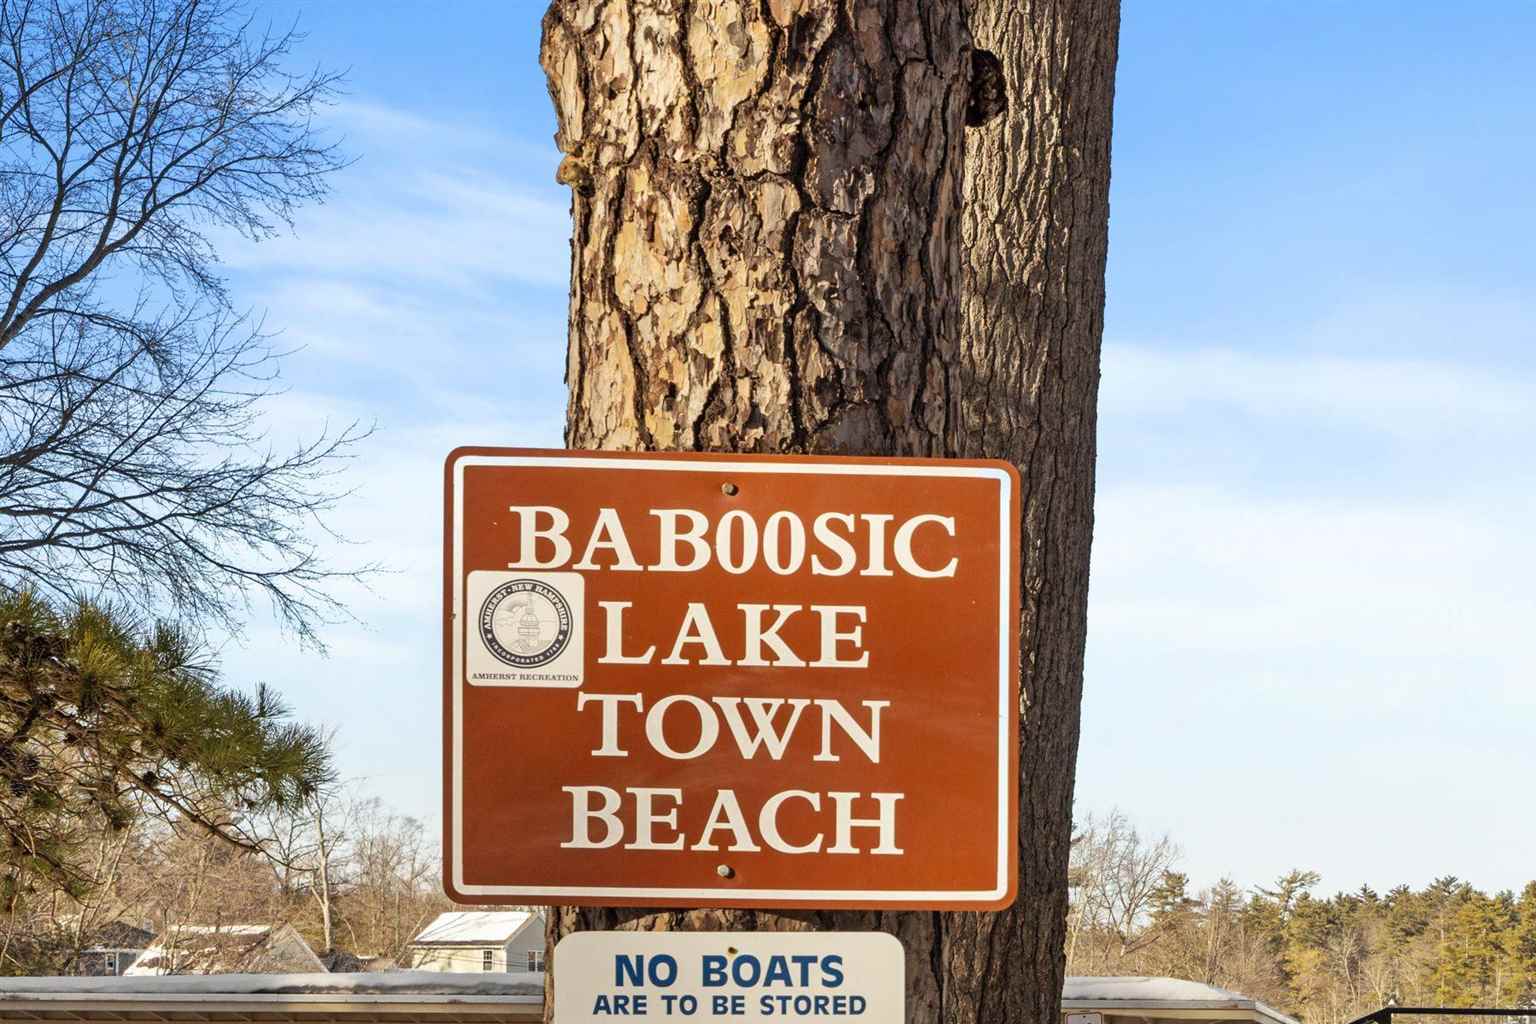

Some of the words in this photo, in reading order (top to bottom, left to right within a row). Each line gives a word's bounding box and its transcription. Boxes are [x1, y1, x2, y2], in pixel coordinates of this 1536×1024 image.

[511, 583, 533, 592] NEW
[535, 584, 568, 631] HAMPSHIRE
[597, 600, 871, 669] LAKE
[472, 672, 517, 680] AMHERST
[518, 673, 579, 681] RECREATION
[577, 691, 891, 765] TOWN
[560, 785, 905, 856] BEACH
[614, 954, 679, 988] NO
[702, 954, 844, 988] BOATS
[592, 995, 648, 1016] ARE
[661, 995, 698, 1016] TO
[712, 995, 745, 1016] BE
[760, 995, 867, 1016] STORED
